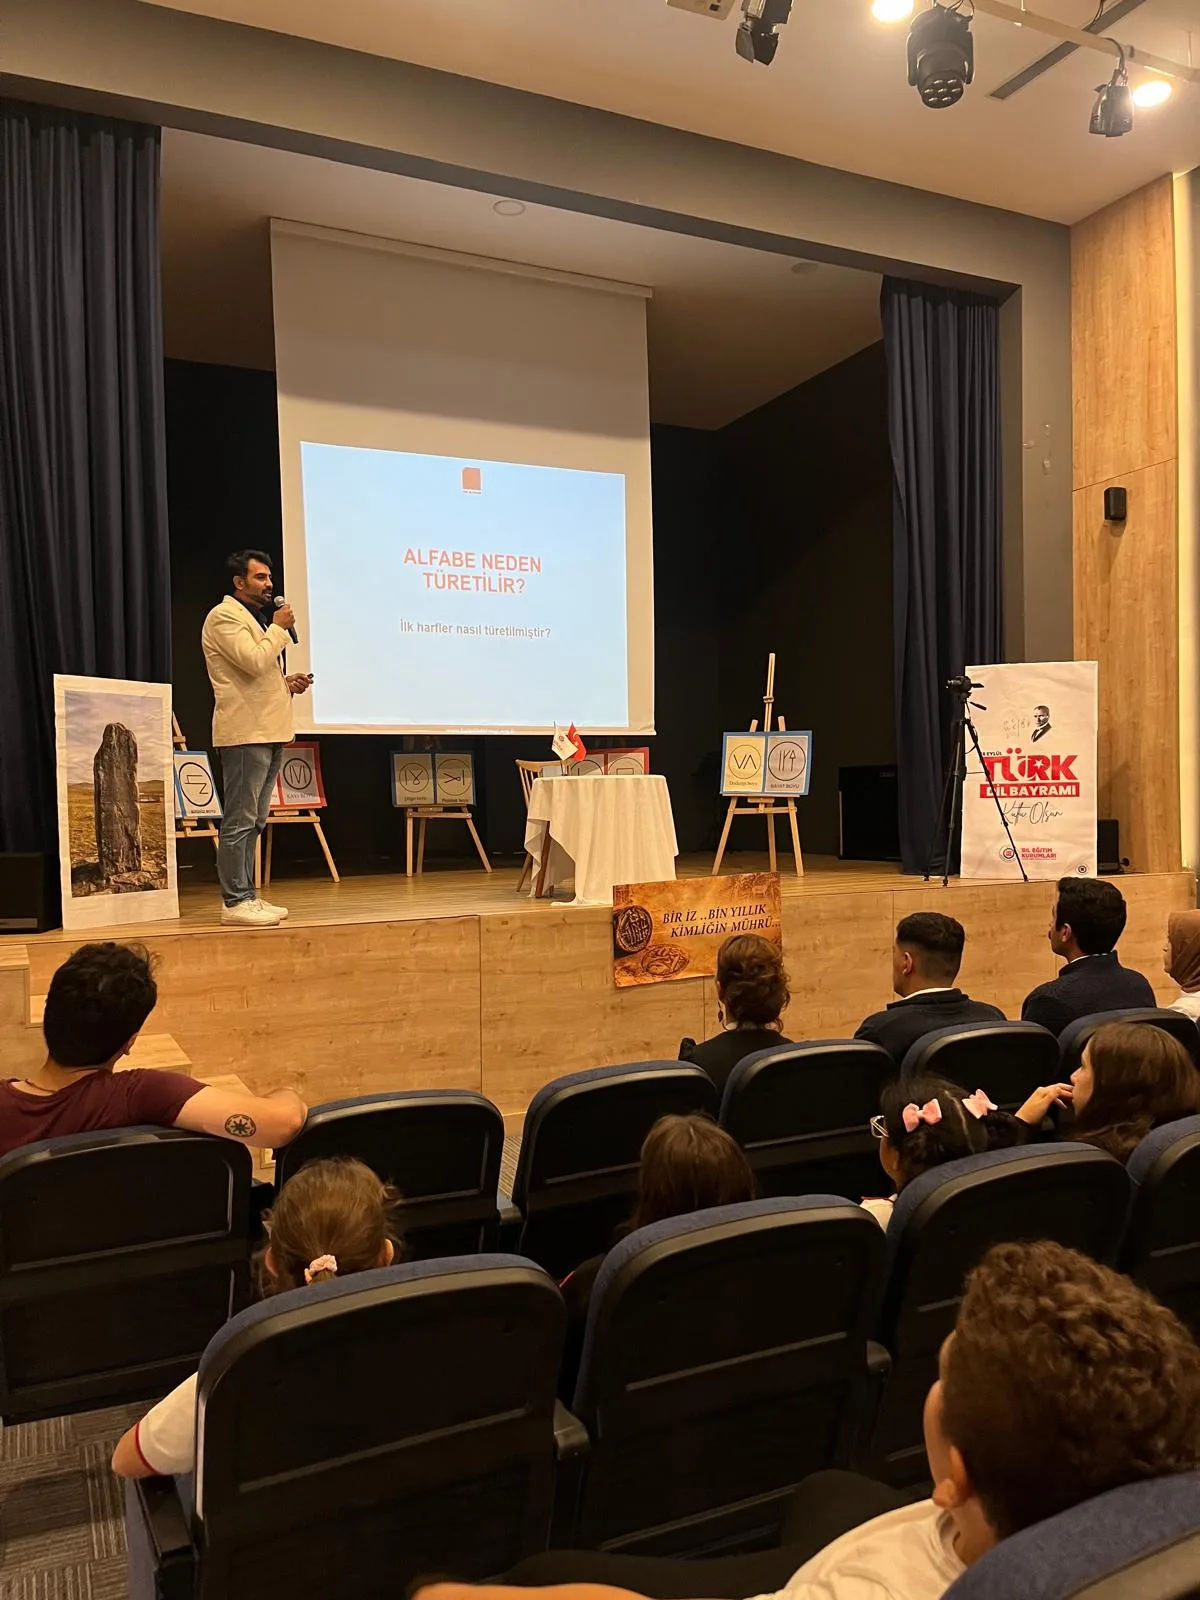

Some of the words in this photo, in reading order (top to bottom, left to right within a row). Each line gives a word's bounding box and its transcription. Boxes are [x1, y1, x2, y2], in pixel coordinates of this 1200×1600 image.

[404, 548, 476, 568] ALFABE
[482, 553, 541, 573] NEDEN
[423, 569, 525, 593] TÜRETİLİR?
[400, 618, 413, 632] İlk
[417, 622, 452, 633] harfler
[456, 625, 481, 635] nasıl
[485, 625, 551, 639] türetilmiştir?
[983, 748, 1079, 781] TÜRK
[1010, 785, 1076, 796] BAYRAMI
[663, 910, 682, 924] BİR
[686, 909, 697, 922] İZ
[731, 903, 767, 917] YILLIK
[671, 921, 727, 938] KİMLİĞİN
